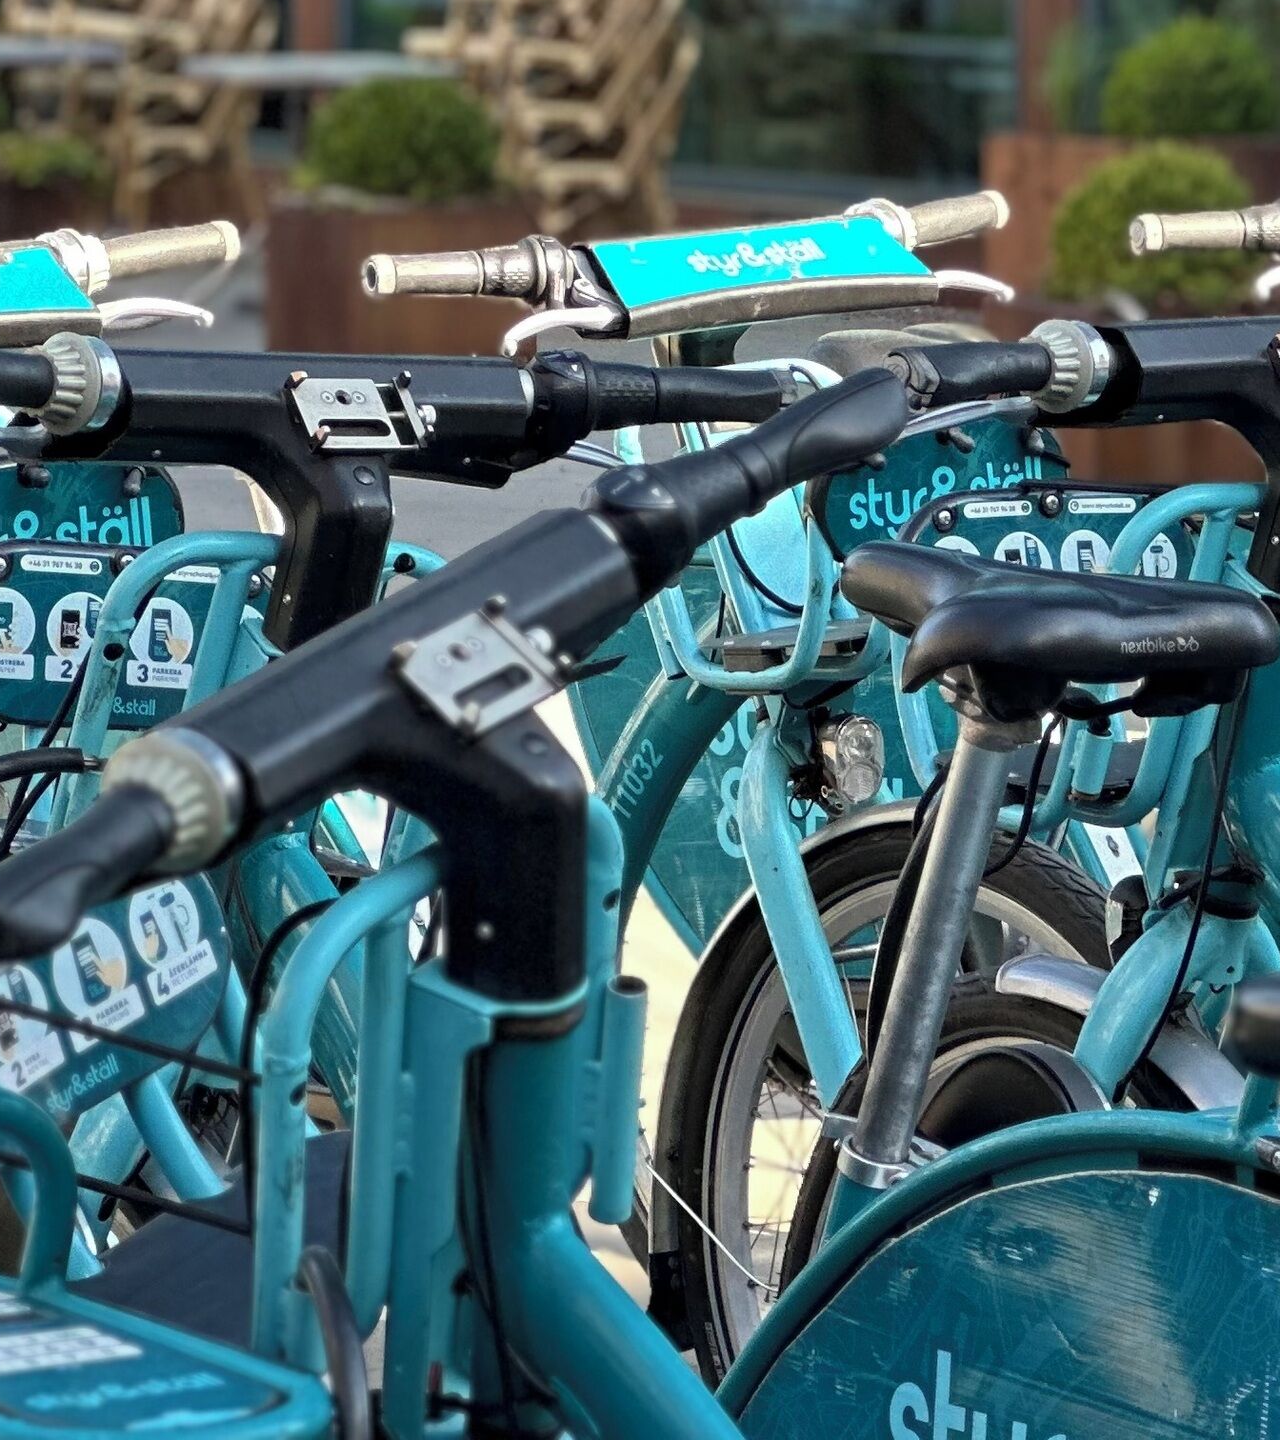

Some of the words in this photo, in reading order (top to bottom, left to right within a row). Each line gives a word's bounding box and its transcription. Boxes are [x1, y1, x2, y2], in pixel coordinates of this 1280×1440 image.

[1120, 636, 1176, 654] nextbike
[60, 656, 73, 679] 2
[136, 664, 149, 682] 3
[10, 1061, 27, 1088] 2
[47, 1052, 120, 1113] styr&ställ
